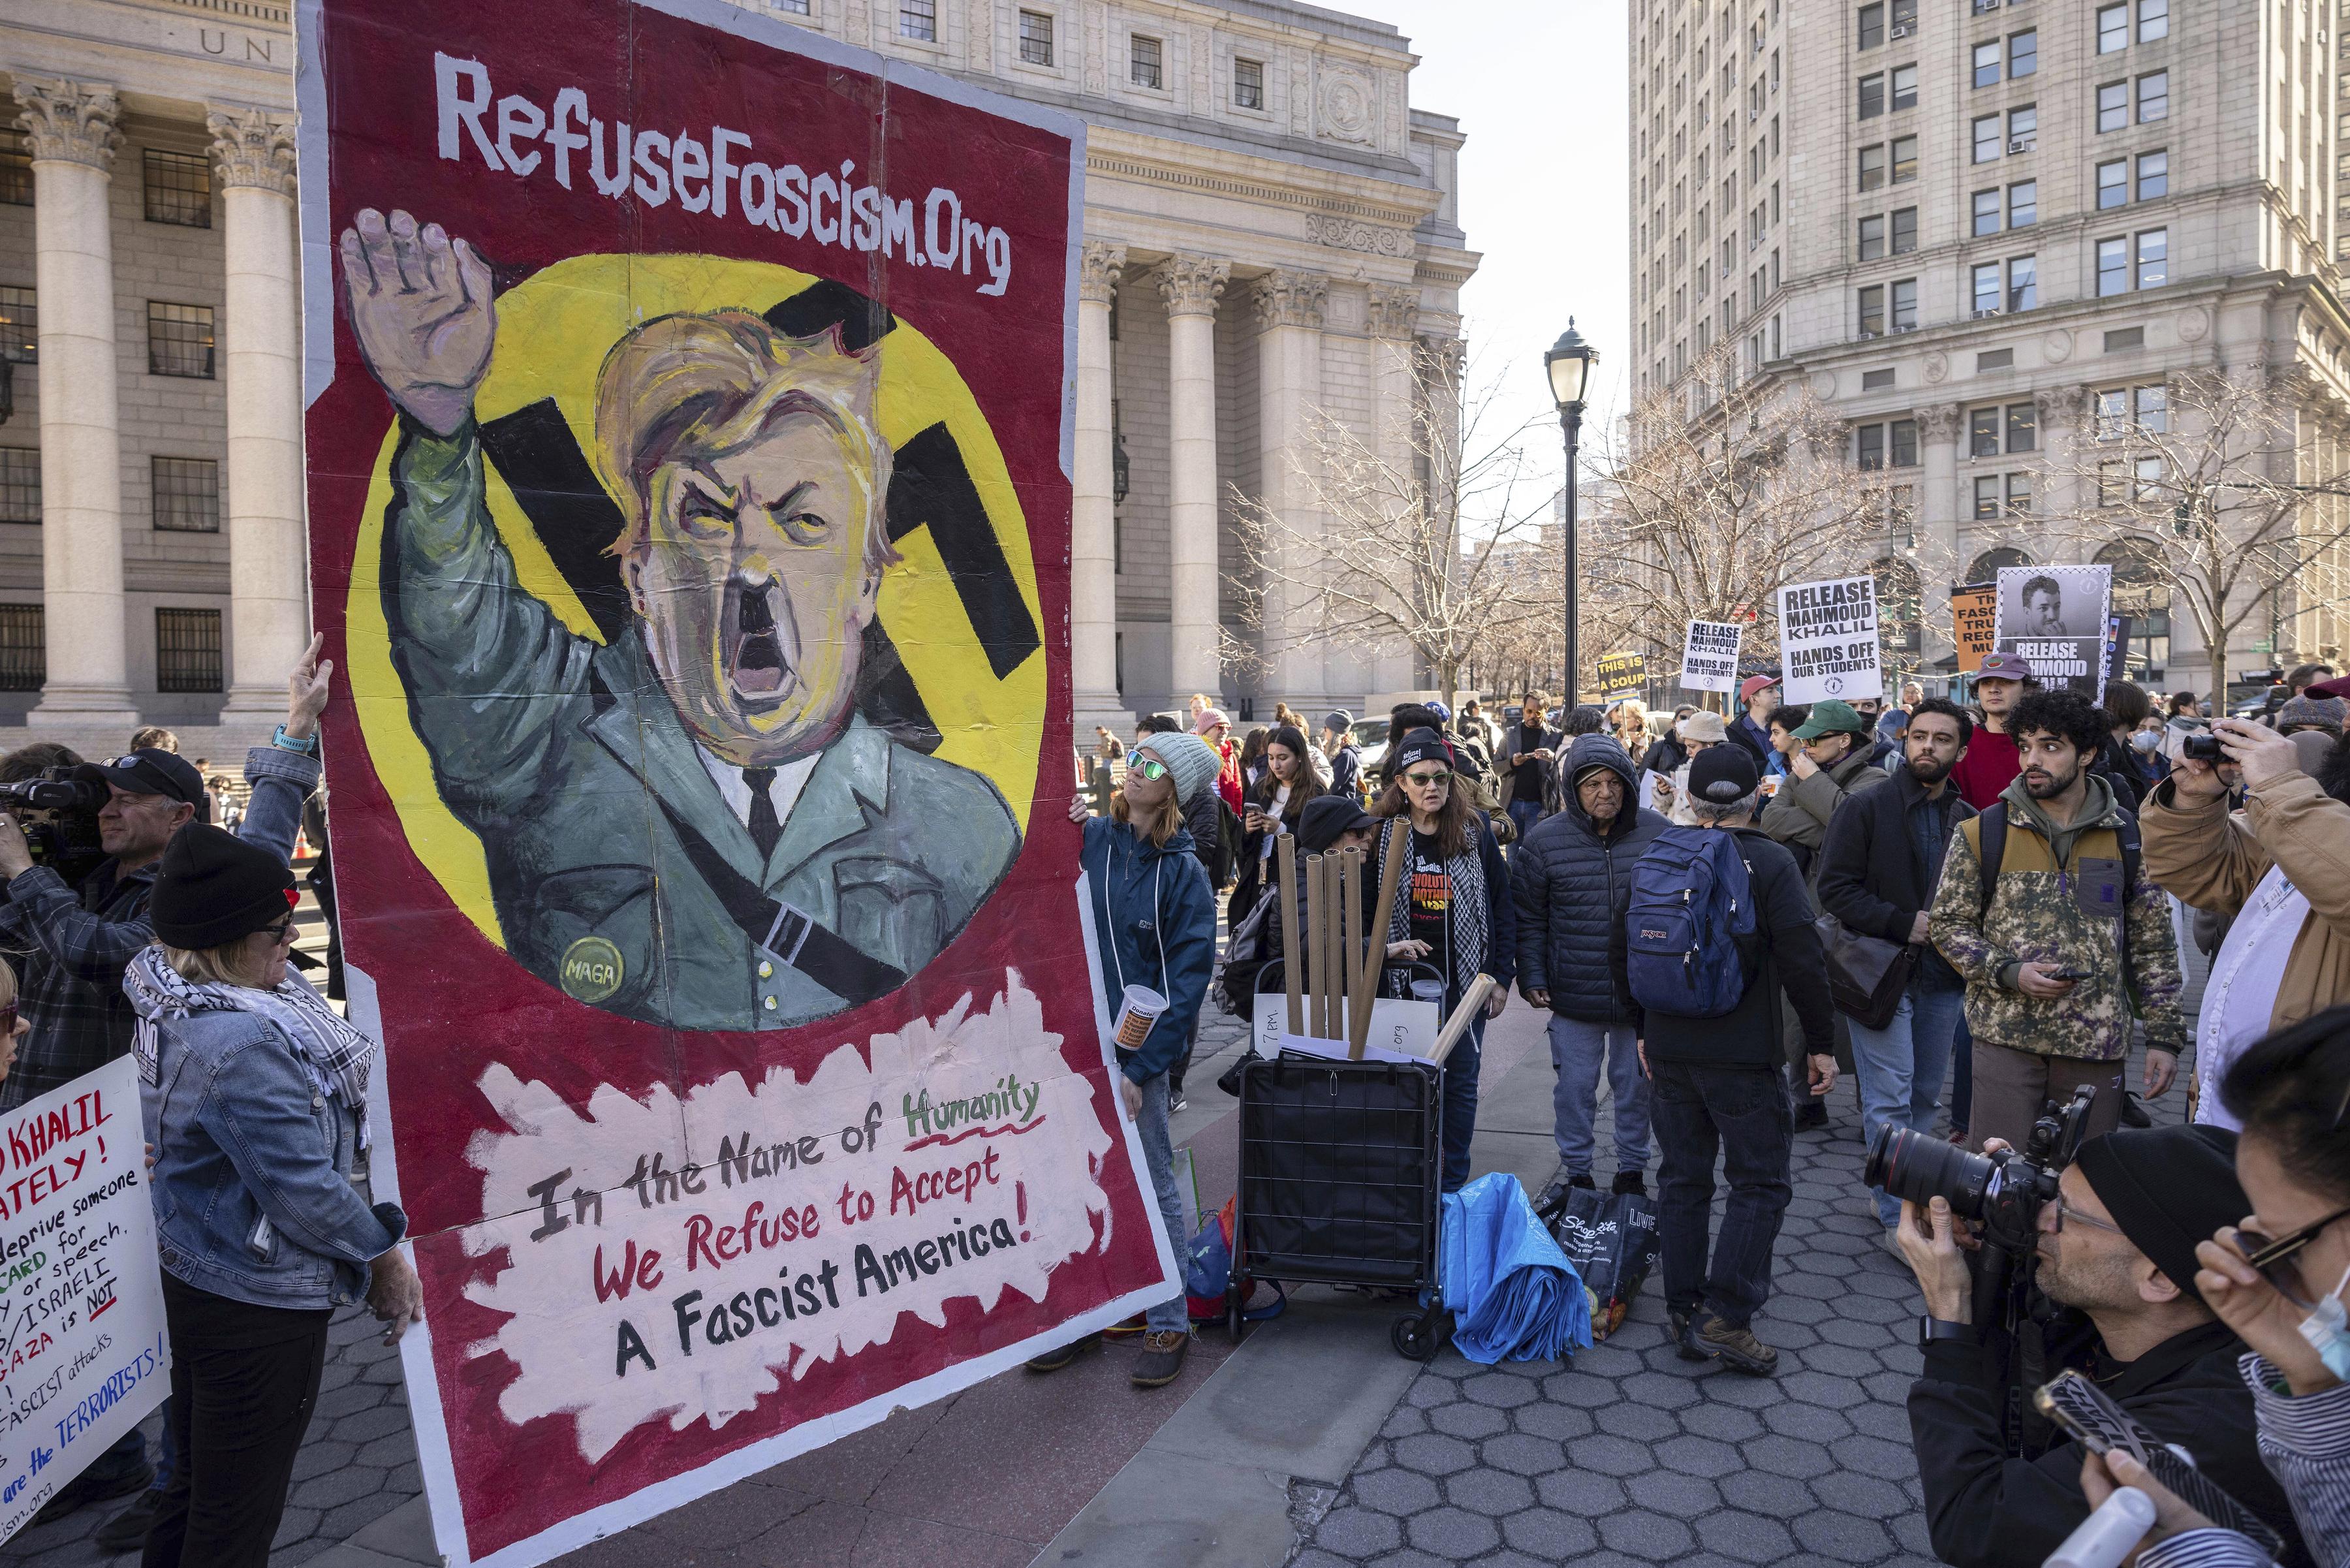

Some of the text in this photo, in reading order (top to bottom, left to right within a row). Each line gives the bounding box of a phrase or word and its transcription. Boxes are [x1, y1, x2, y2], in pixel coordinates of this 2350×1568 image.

[434, 52, 1011, 296] RefuseFascism.Org
[1785, 580, 1871, 612] RELEASE
[1786, 602, 1872, 628] MAHMOUD
[1693, 623, 1740, 639] RELEASE
[1787, 619, 1874, 641] KHALIL
[1689, 645, 1737, 656] KHALIL
[1691, 635, 1738, 648] MAHMOUD
[2016, 642, 2078, 659] RELEASE
[1687, 658, 1734, 670] HANDS OFF
[1790, 645, 1843, 666] HANDS
[1848, 641, 1874, 659] OFF
[1597, 657, 1643, 674] THIS IS
[1700, 668, 1733, 678] STUDENTS
[1791, 657, 1875, 679] OUR STUDENTS
[1600, 673, 1646, 691] A COUP
[1416, 855, 1426, 866] BA
[1417, 862, 1443, 873] speaks:
[566, 959, 614, 986] MAGA
[1132, 1006, 1155, 1017] Donate!
[1263, 1034, 1278, 1044] 7
[8, 1090, 113, 1170] KHALIL
[527, 1074, 1041, 1243] In the Name of Humanity
[73, 1170, 138, 1217] someone
[594, 1146, 1000, 1304] We Refuse to Accept
[1629, 1208, 1655, 1231] LIVE
[58, 1225, 86, 1254] for
[1563, 1241, 1577, 1251] make
[24, 1277, 42, 1296] or
[616, 1179, 1031, 1377] A Fascist America!
[61, 1311, 77, 1332] is
[87, 1276, 118, 1315] NOT
[69, 1333, 112, 1380] attacks
[3, 1331, 163, 1504] are the TERRORISTS!
